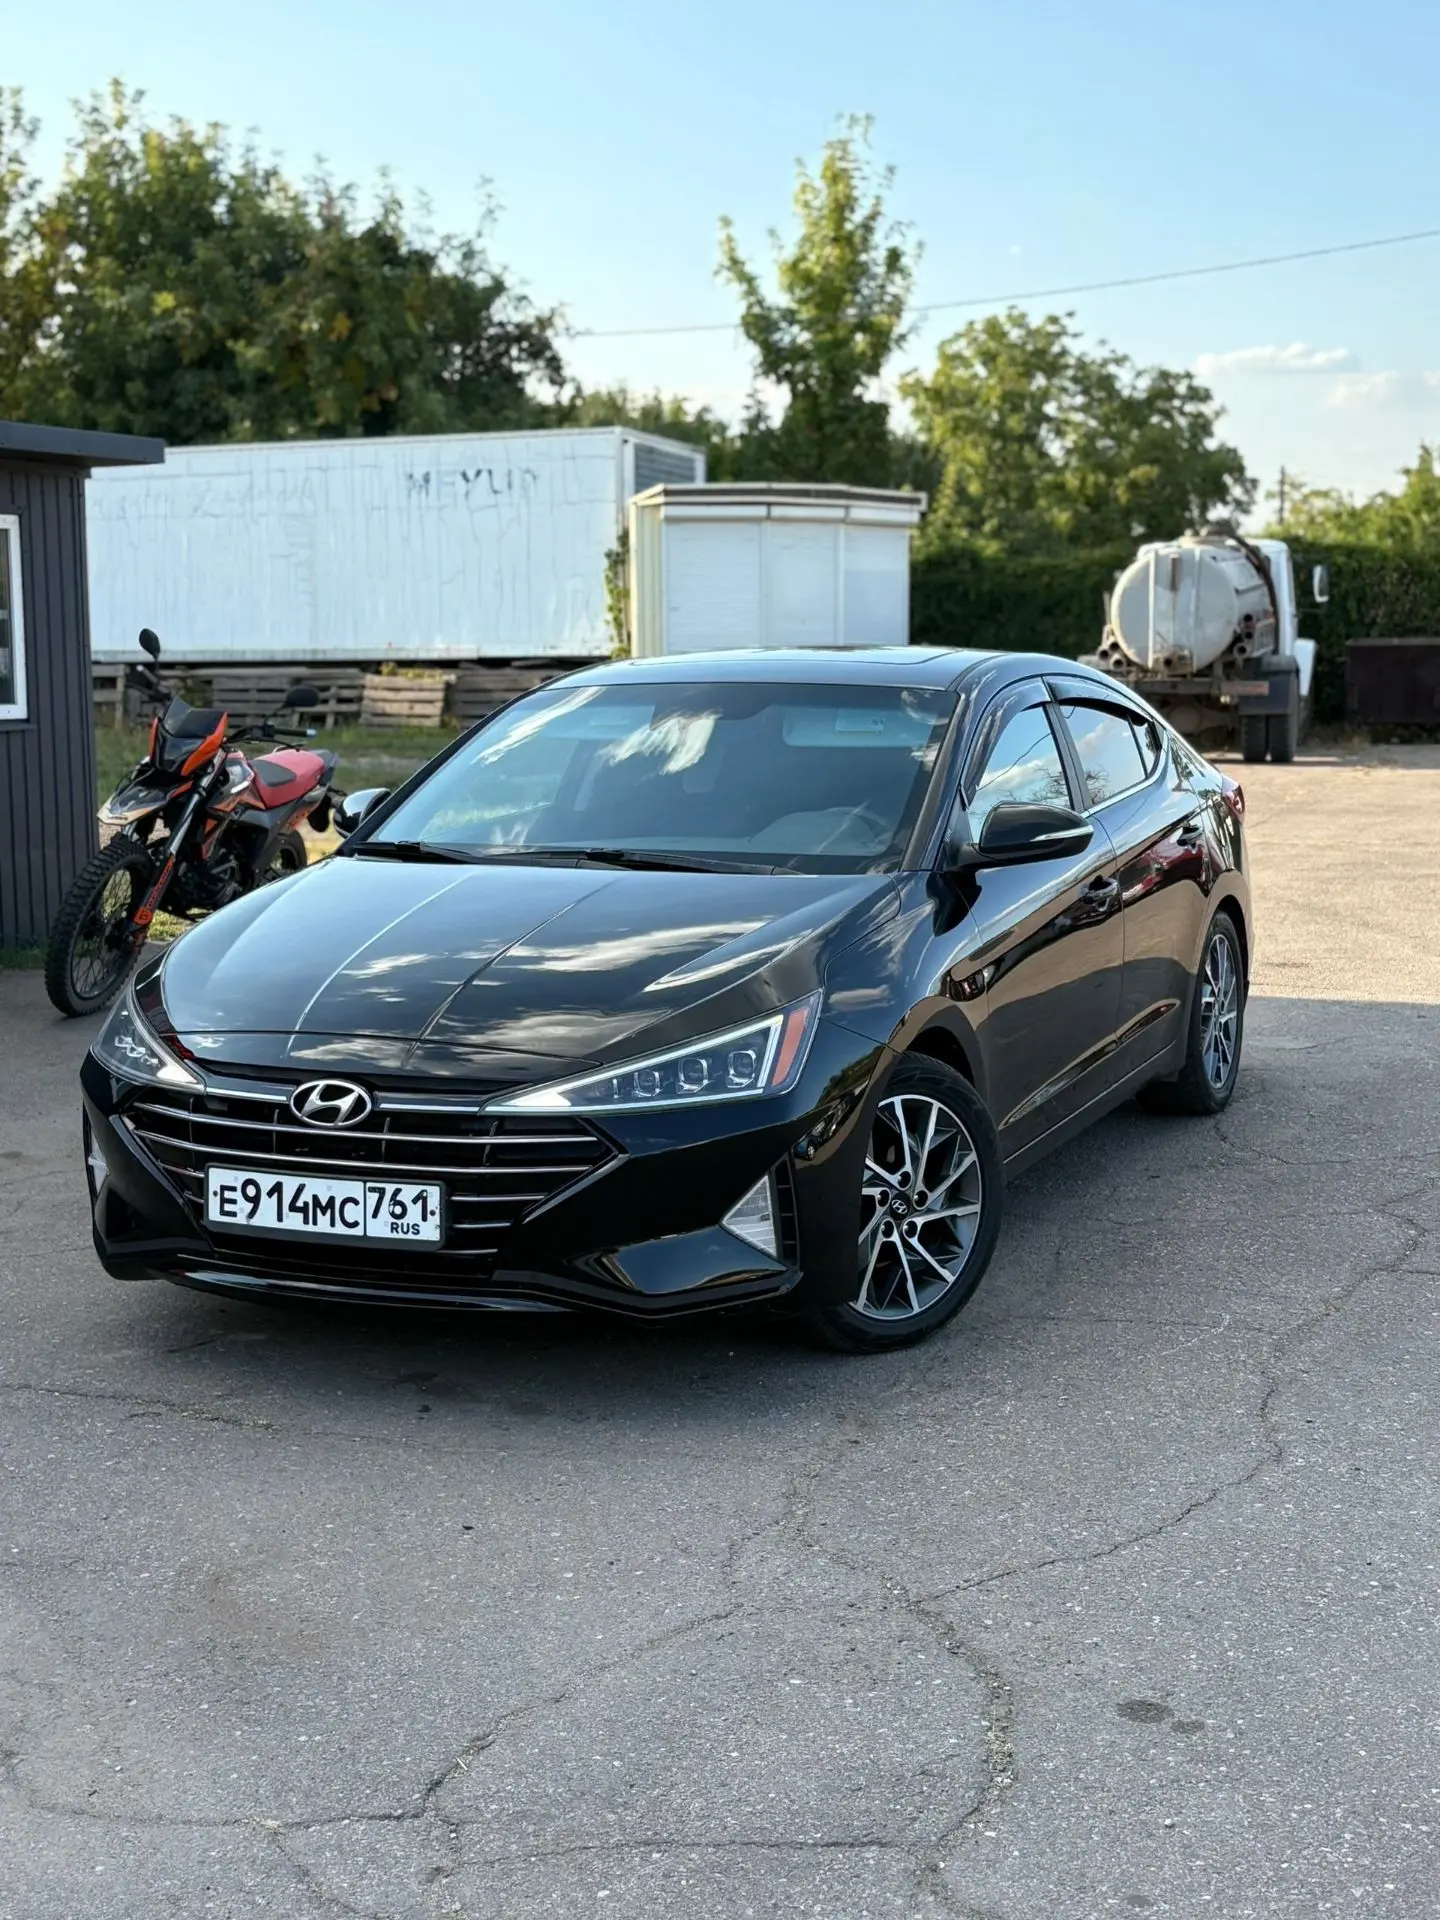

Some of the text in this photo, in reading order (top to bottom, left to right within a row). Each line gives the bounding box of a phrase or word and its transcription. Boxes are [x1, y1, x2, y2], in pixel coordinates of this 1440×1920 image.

[219, 1177, 429, 1229] E914MC 761
[389, 1223, 421, 1236] RUS
